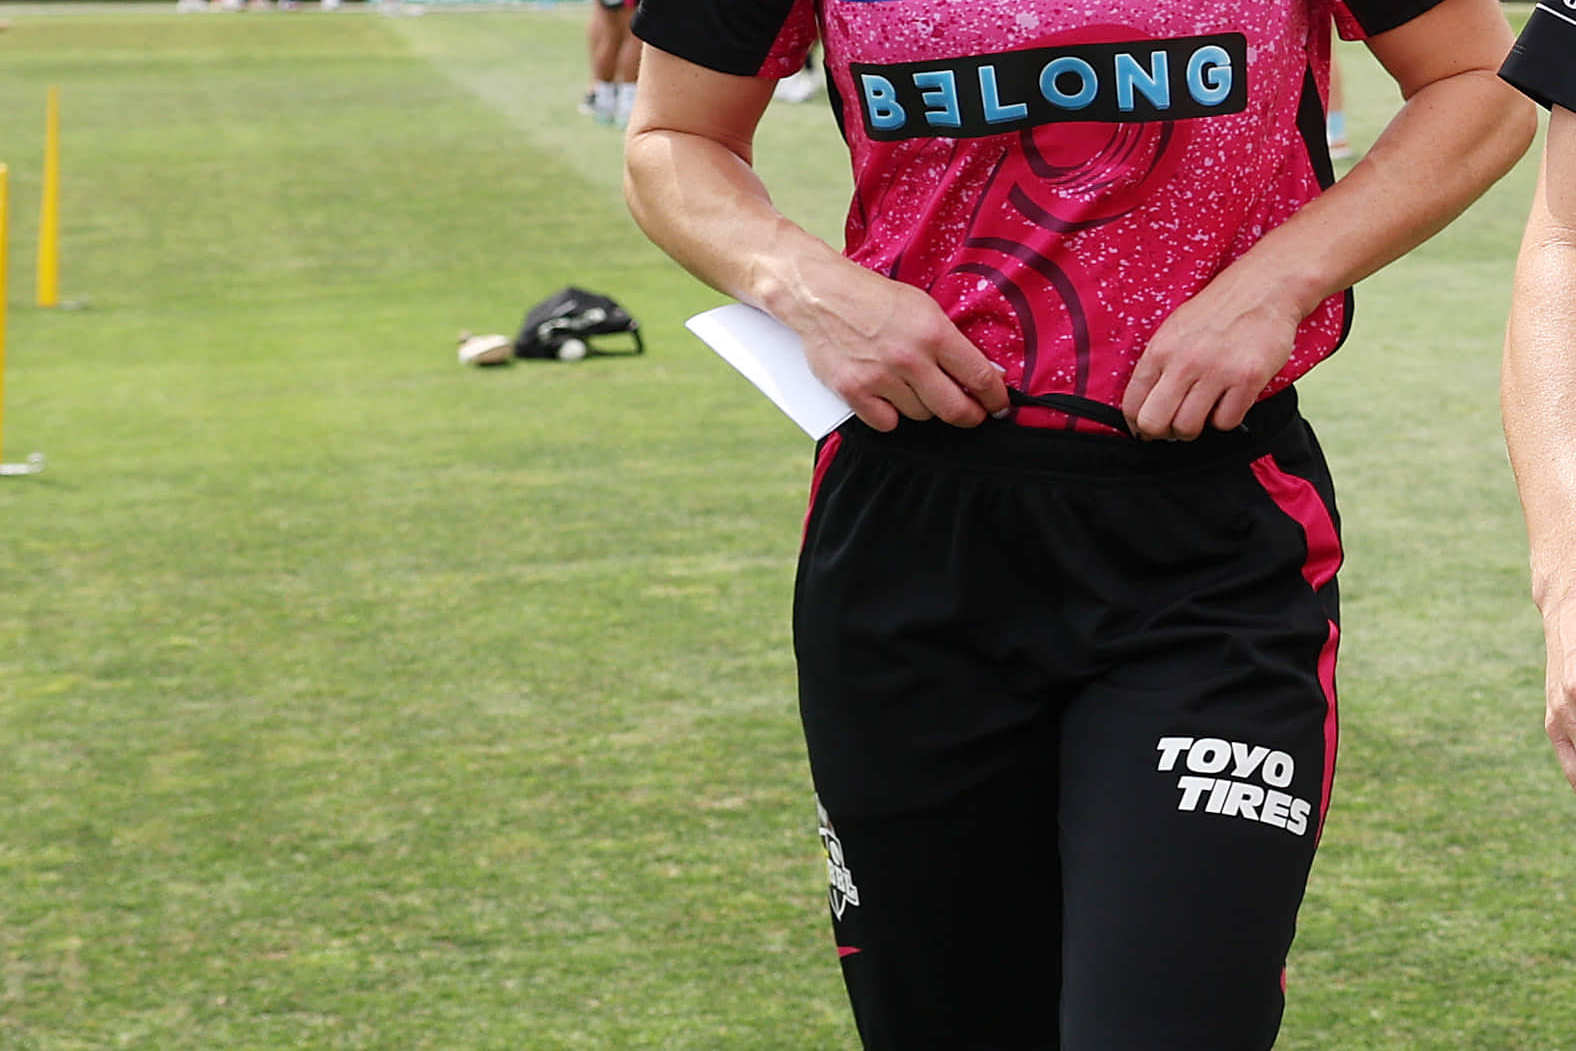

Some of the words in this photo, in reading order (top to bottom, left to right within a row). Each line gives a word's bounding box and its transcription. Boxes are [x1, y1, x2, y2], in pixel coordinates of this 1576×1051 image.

[861, 45, 1233, 130] BELONG
[1156, 737, 1295, 789] TOYO
[1176, 776, 1312, 837] TIRES
